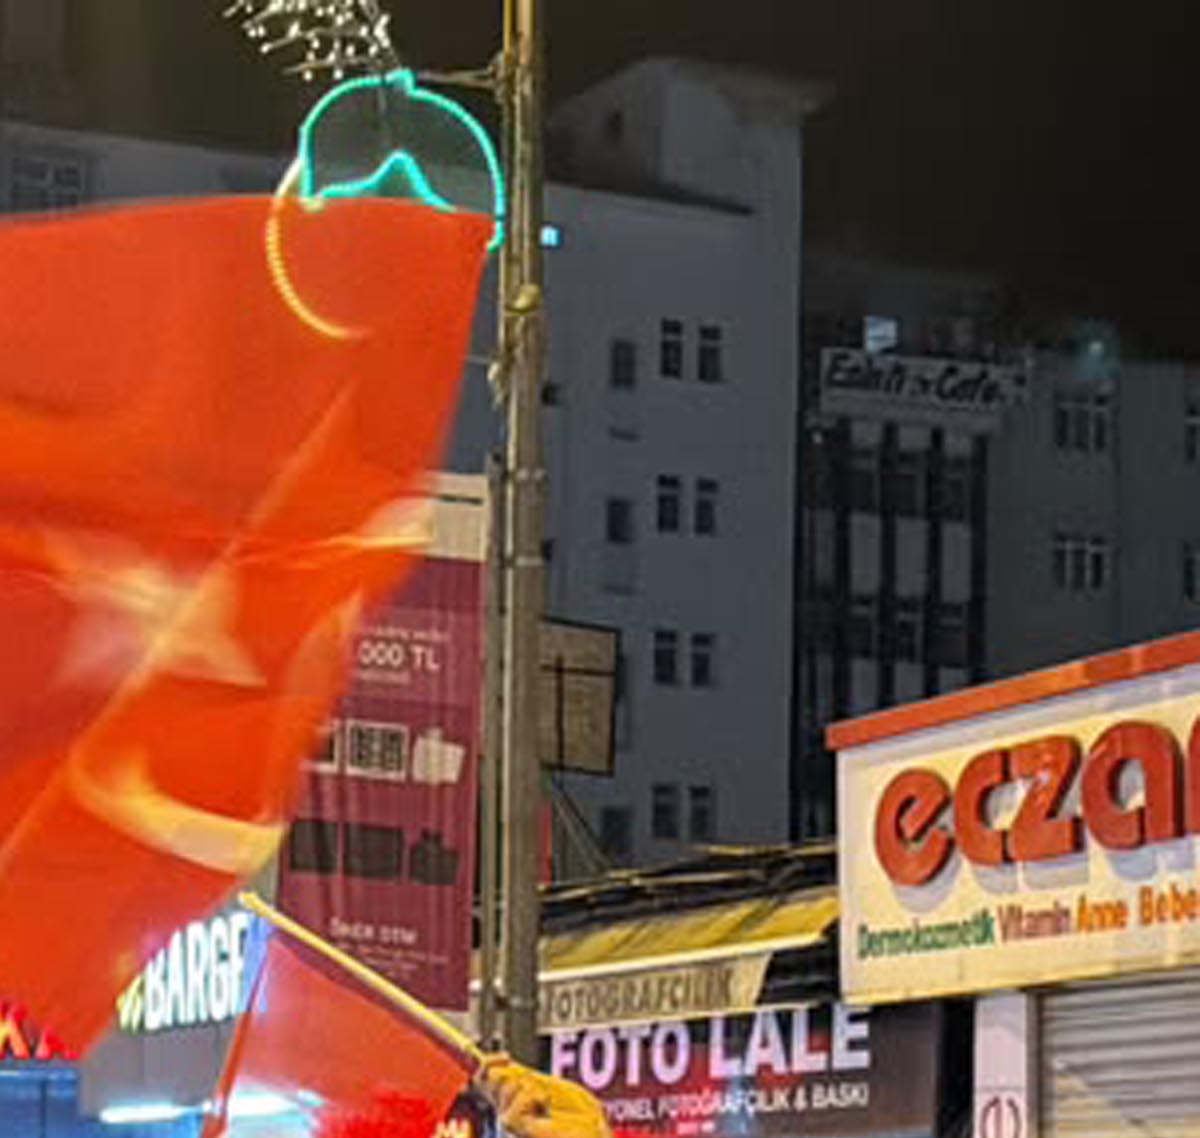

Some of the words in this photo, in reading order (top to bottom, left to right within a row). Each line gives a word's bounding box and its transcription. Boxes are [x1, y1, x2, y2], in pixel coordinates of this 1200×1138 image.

[409, 644, 441, 672] TL
[875, 715, 1200, 887] ecza
[998, 900, 1071, 942] Vitamin
[1077, 895, 1129, 932] Anne
[551, 1019, 691, 1090] FOTO
[708, 1003, 871, 1079] LALE
[603, 1098, 655, 1121] YONEL
[812, 1081, 869, 1110] BASKI
